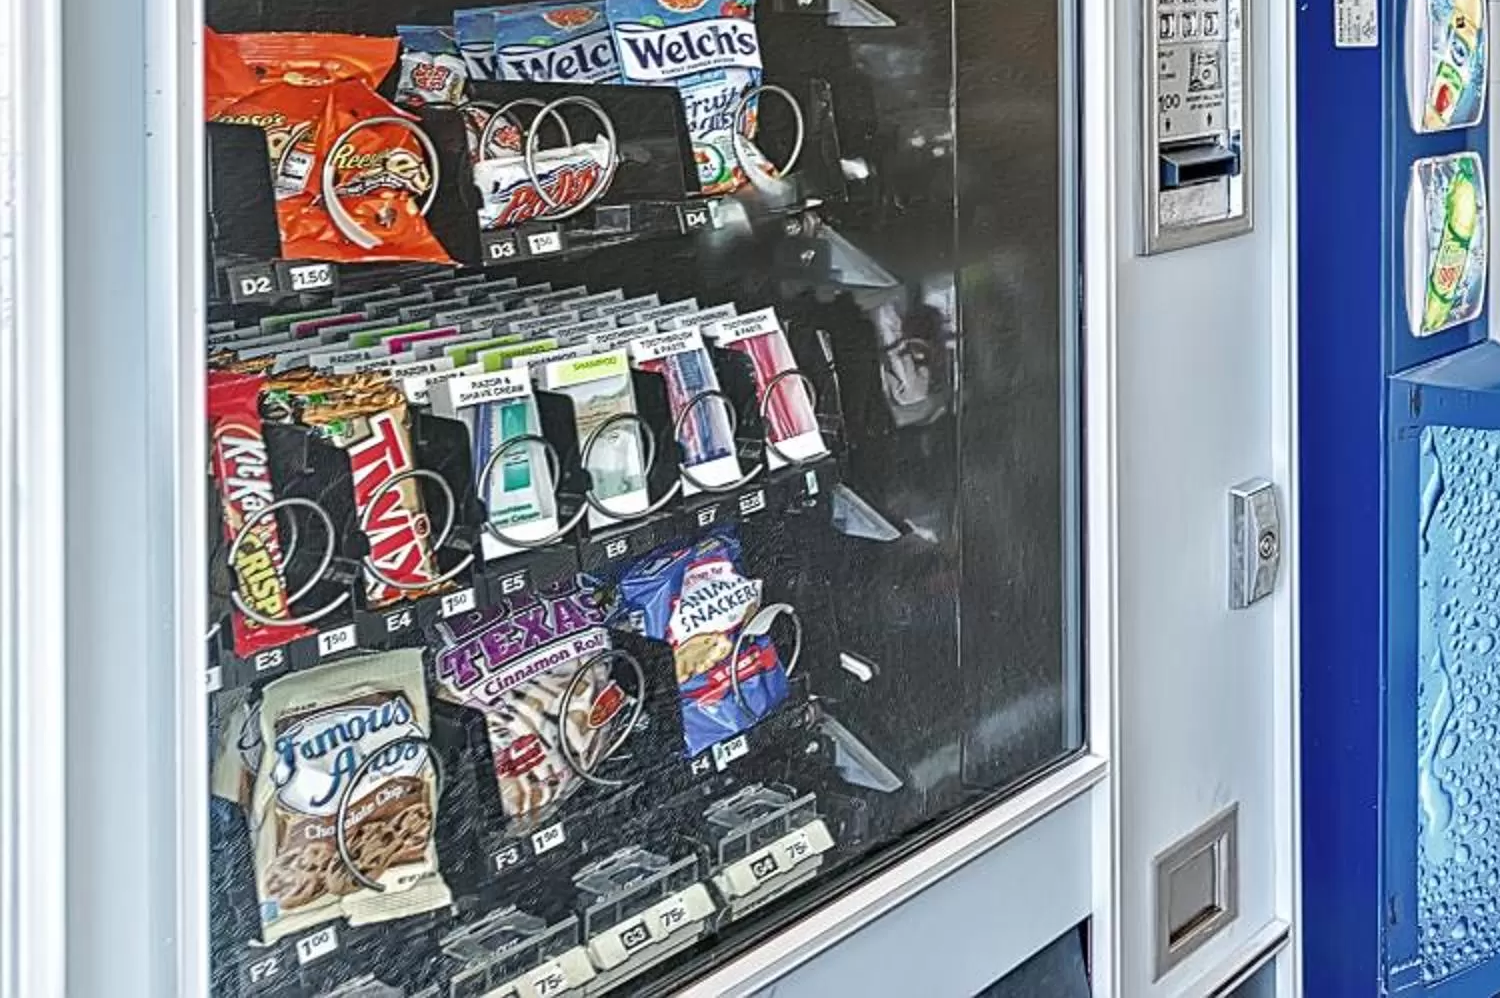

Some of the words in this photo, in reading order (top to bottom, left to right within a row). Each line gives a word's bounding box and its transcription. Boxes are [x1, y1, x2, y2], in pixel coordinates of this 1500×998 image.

[624, 24, 757, 69] Welch's
[686, 212, 708, 227] D4
[491, 242, 515, 258] D3
[240, 277, 272, 295] D2
[502, 575, 526, 593] E5
[680, 578, 742, 614] ANIM
[681, 581, 759, 633] SNACKERS
[387, 611, 413, 631] E4
[441, 592, 608, 687] TEXAS
[255, 650, 284, 671] E3
[484, 649, 570, 696] Cinnamon
[275, 698, 410, 787] Famous
[305, 802, 375, 840] Choolate
[496, 849, 518, 869] F3
[250, 959, 279, 981] F2
